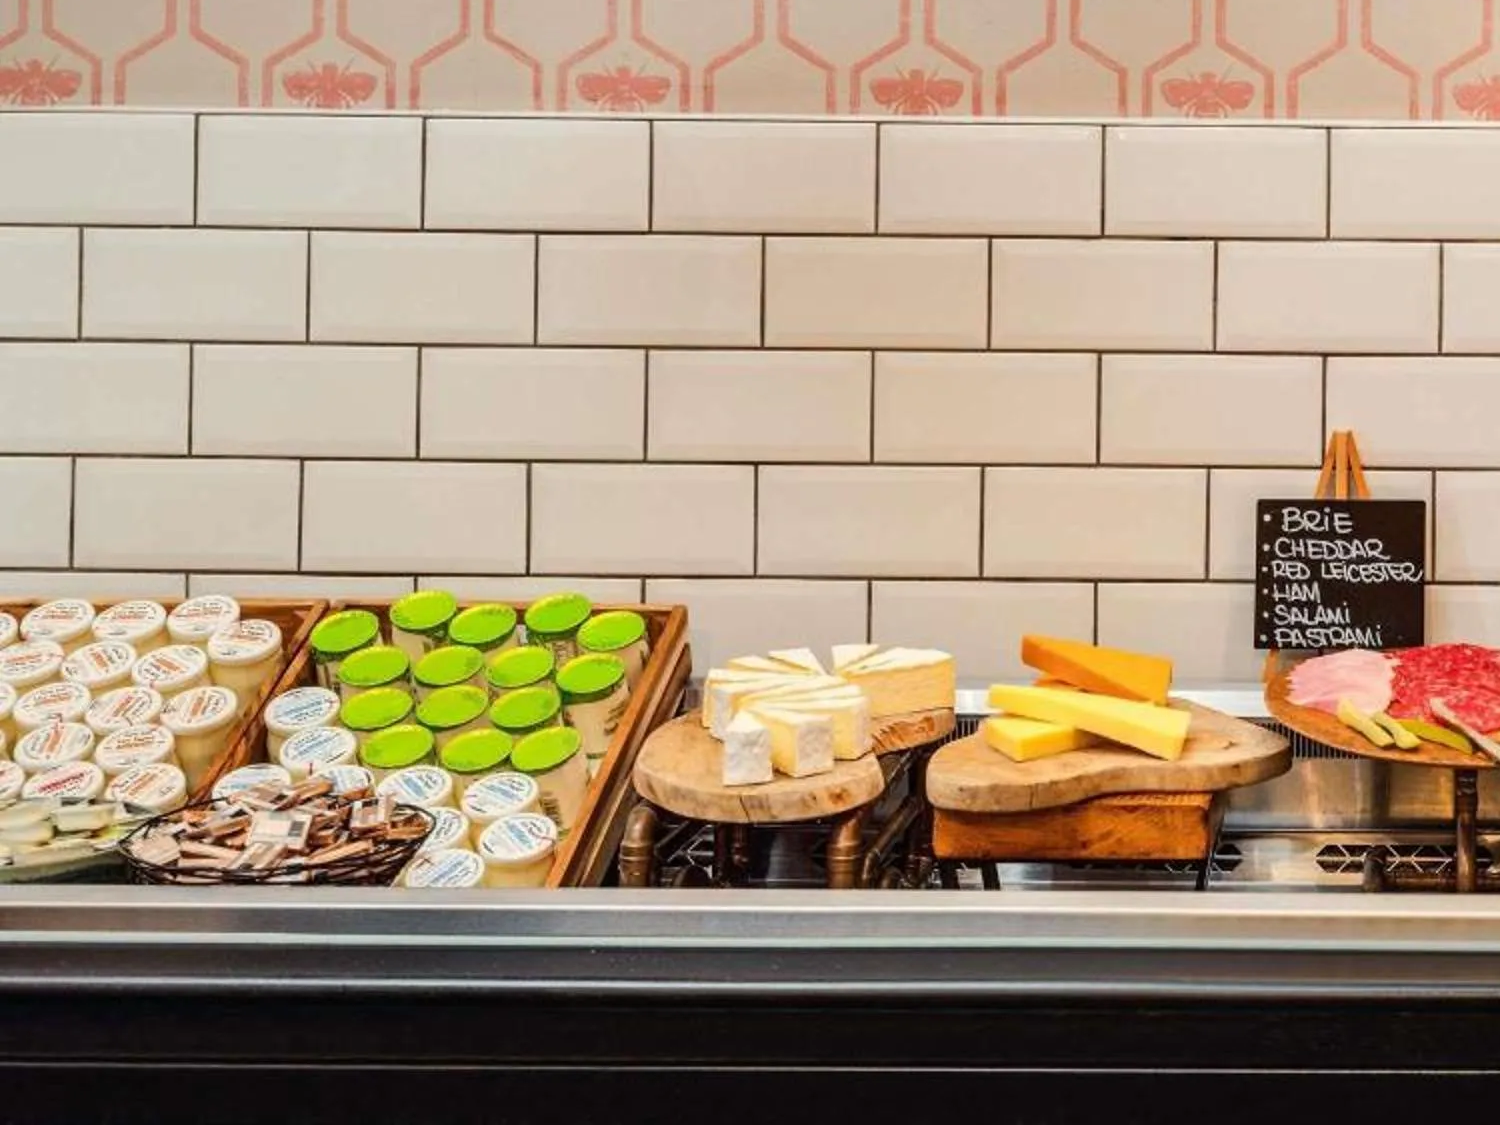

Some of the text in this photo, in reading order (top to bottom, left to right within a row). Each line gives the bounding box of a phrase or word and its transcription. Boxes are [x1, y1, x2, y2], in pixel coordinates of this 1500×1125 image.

[1274, 537, 1391, 561] CHEDDAR
[1272, 560, 1311, 580] RED
[1272, 581, 1321, 603] HAM
